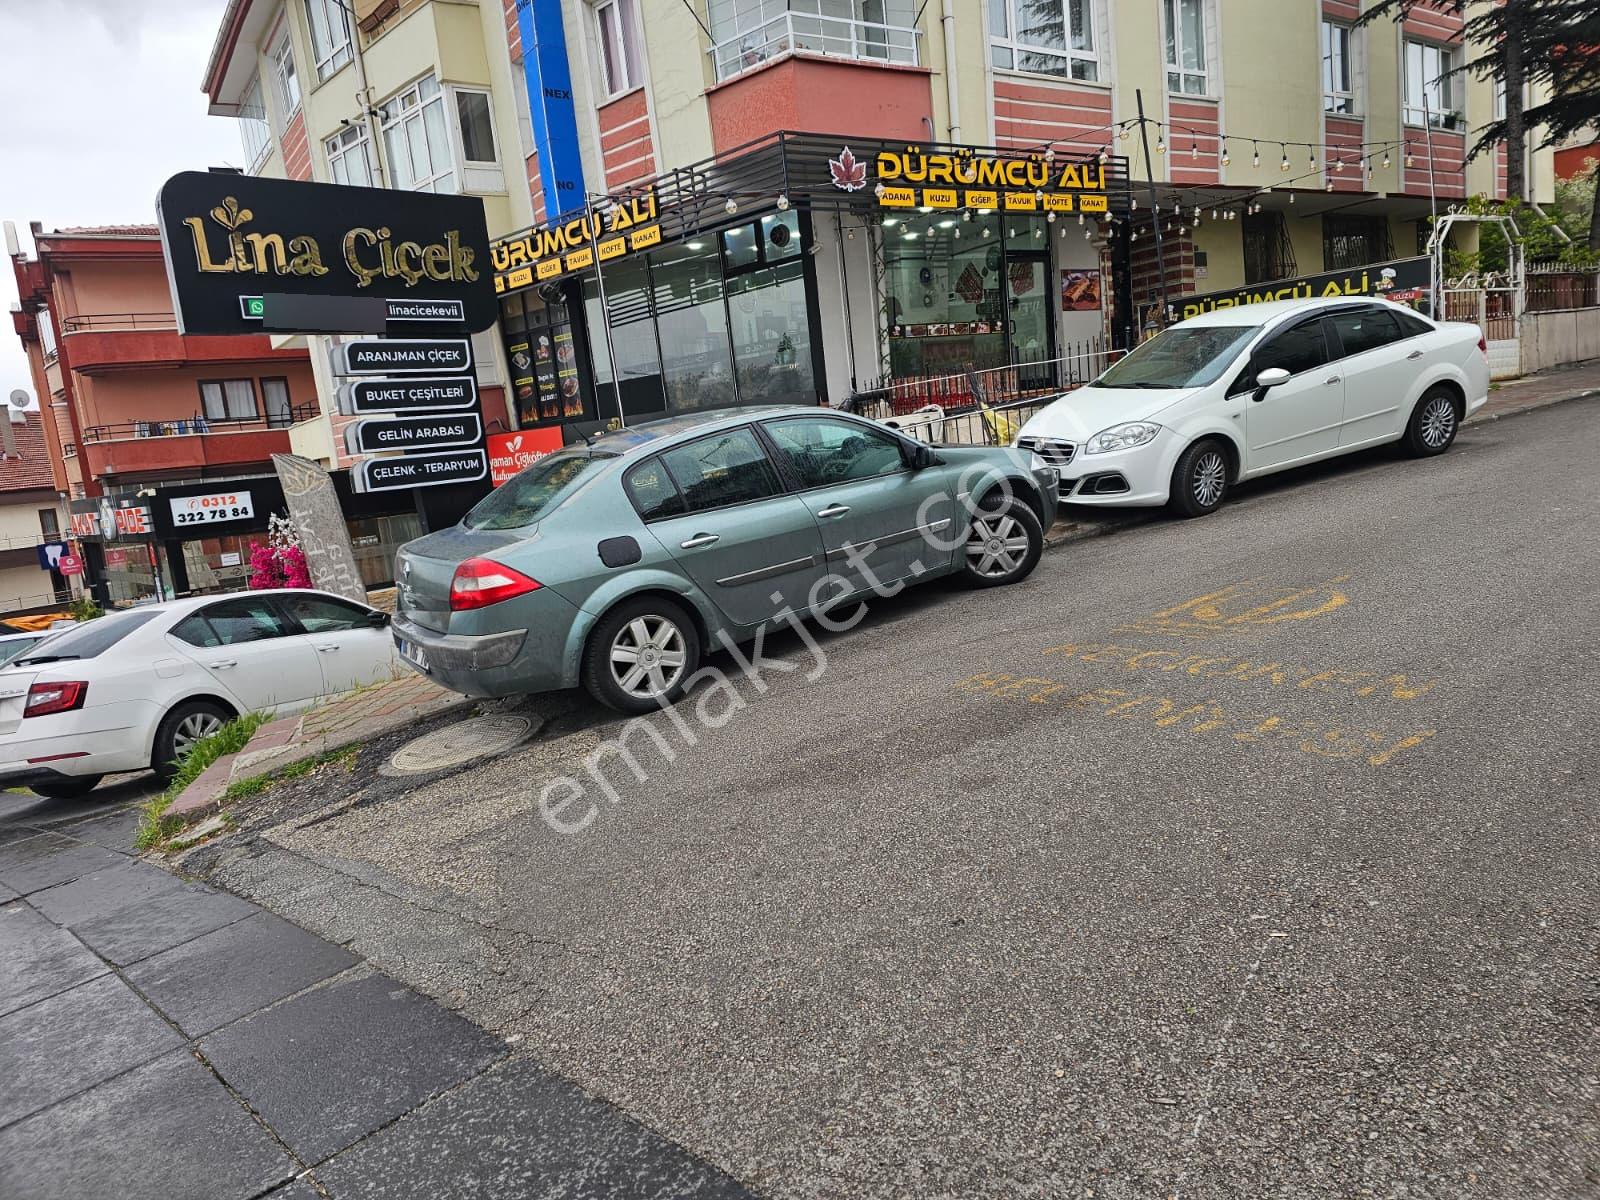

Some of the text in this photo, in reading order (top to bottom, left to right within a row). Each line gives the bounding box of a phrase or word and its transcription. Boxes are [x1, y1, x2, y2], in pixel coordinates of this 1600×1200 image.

[877, 145, 1049, 187] DÜRÜMCÜ
[882, 192, 912, 201] ADANA
[929, 194, 951, 202] KUZU
[1008, 197, 1032, 205] TAVUK
[1081, 199, 1104, 207] KANAT
[609, 184, 657, 232] ALİ
[182, 195, 479, 288] Lina Çiçek
[634, 231, 657, 244] KANAT
[569, 254, 590, 265] TAVUK
[513, 273, 528, 282] KUZU
[1321, 271, 1368, 297] ALİ
[389, 304, 458, 316] linacicekevii
[357, 349, 461, 363] ARANJMAN ÇİÇEK
[366, 385, 464, 401] BUKET ÇEŞİTLERİ
[378, 425, 465, 441] GELİN ARABASI
[373, 465, 416, 480] ÇELENK
[424, 459, 480, 473] TERARYUM
[202, 495, 237, 507] 0312
[178, 507, 249, 523] 322 78 84
